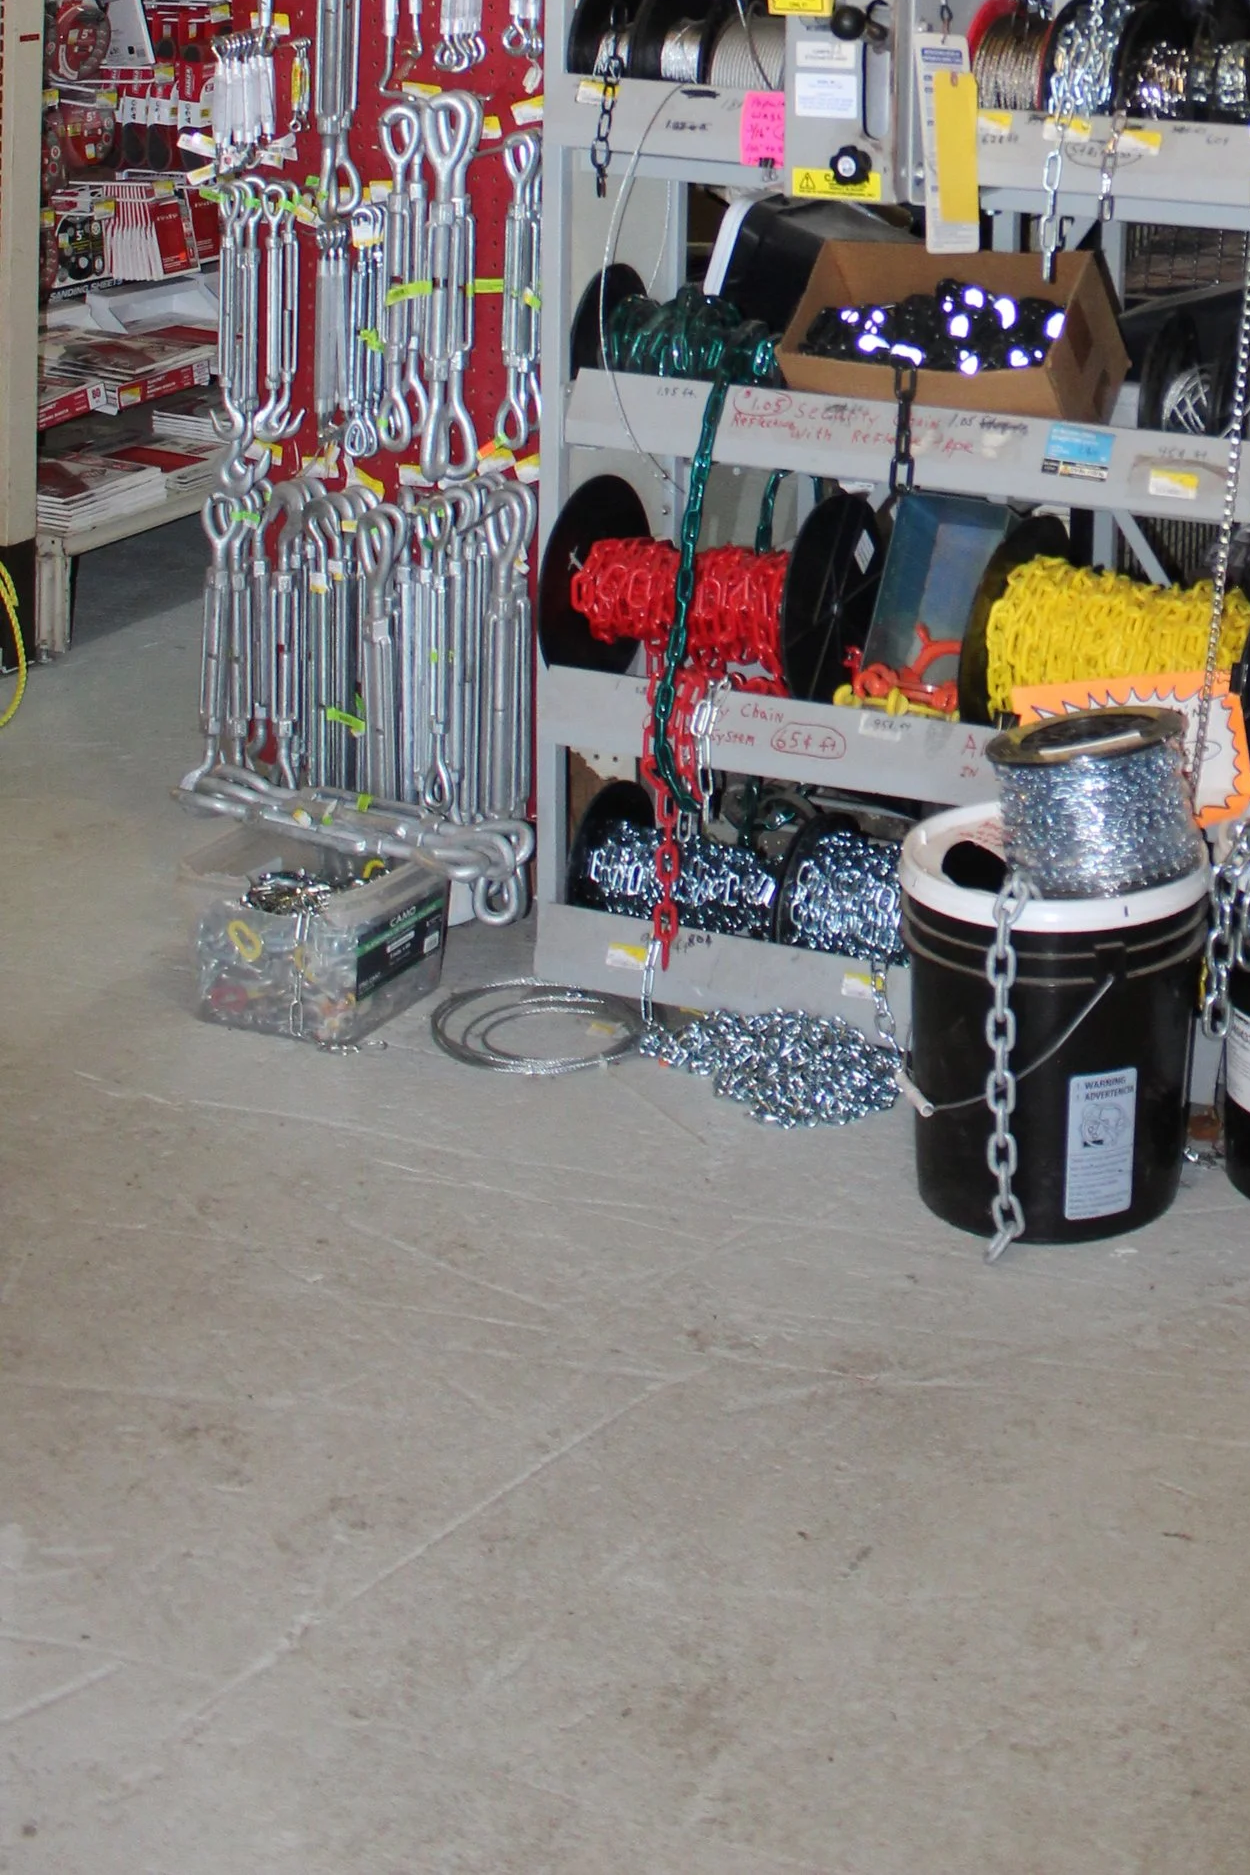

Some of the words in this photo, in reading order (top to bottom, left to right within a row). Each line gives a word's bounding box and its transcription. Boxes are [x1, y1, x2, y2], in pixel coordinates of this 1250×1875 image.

[50, 284, 89, 301] SANDING
[390, 905, 417, 927] CAMO
[1084, 1076, 1127, 1090] WARNING
